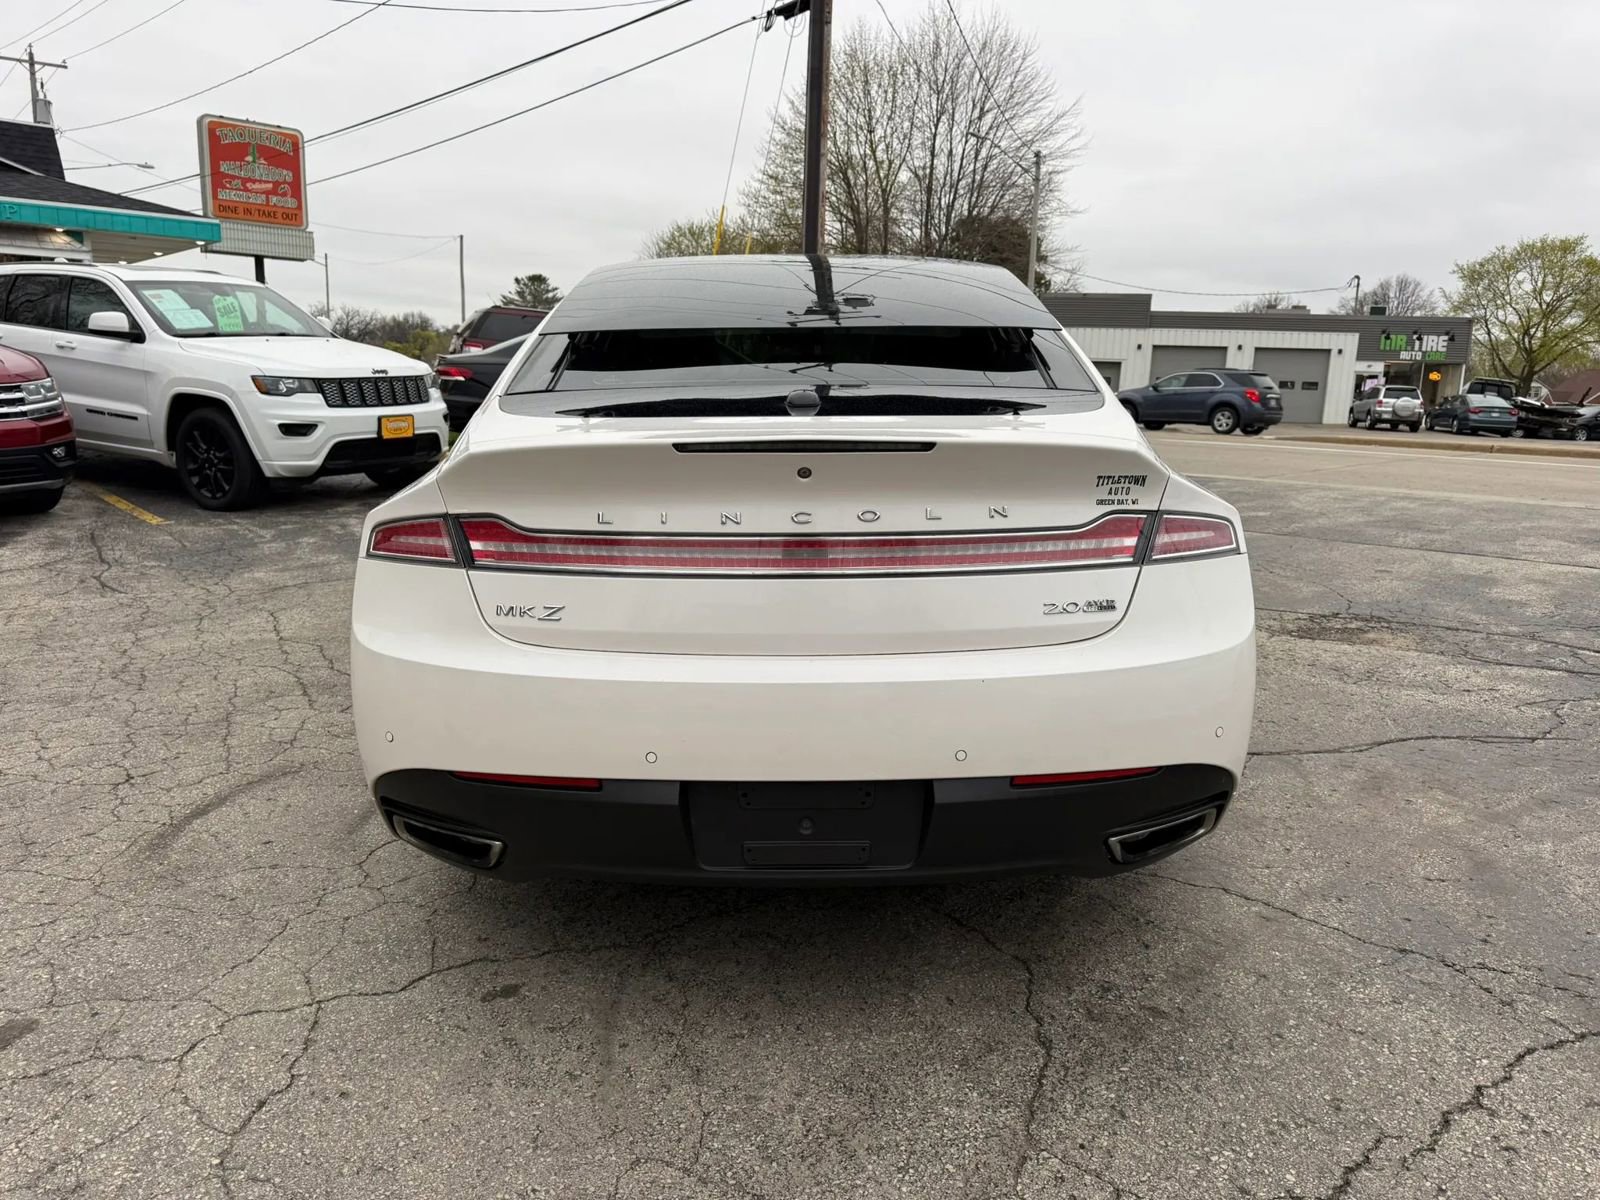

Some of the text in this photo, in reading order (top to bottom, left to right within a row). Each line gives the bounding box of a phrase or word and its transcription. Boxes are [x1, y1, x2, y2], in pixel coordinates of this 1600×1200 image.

[216, 127, 293, 155] TAQUERIA
[217, 188, 298, 208] MEXICAN FOOD
[218, 204, 240, 215] DINE
[281, 212, 299, 221] OUT
[1413, 334, 1449, 351] TIRE
[1400, 351, 1447, 360] AUTO CARE
[1096, 475, 1148, 487] TITLETOWN
[1107, 486, 1131, 496] AUTO
[597, 505, 1009, 525] LINCOLN
[496, 604, 566, 621] MKZ
